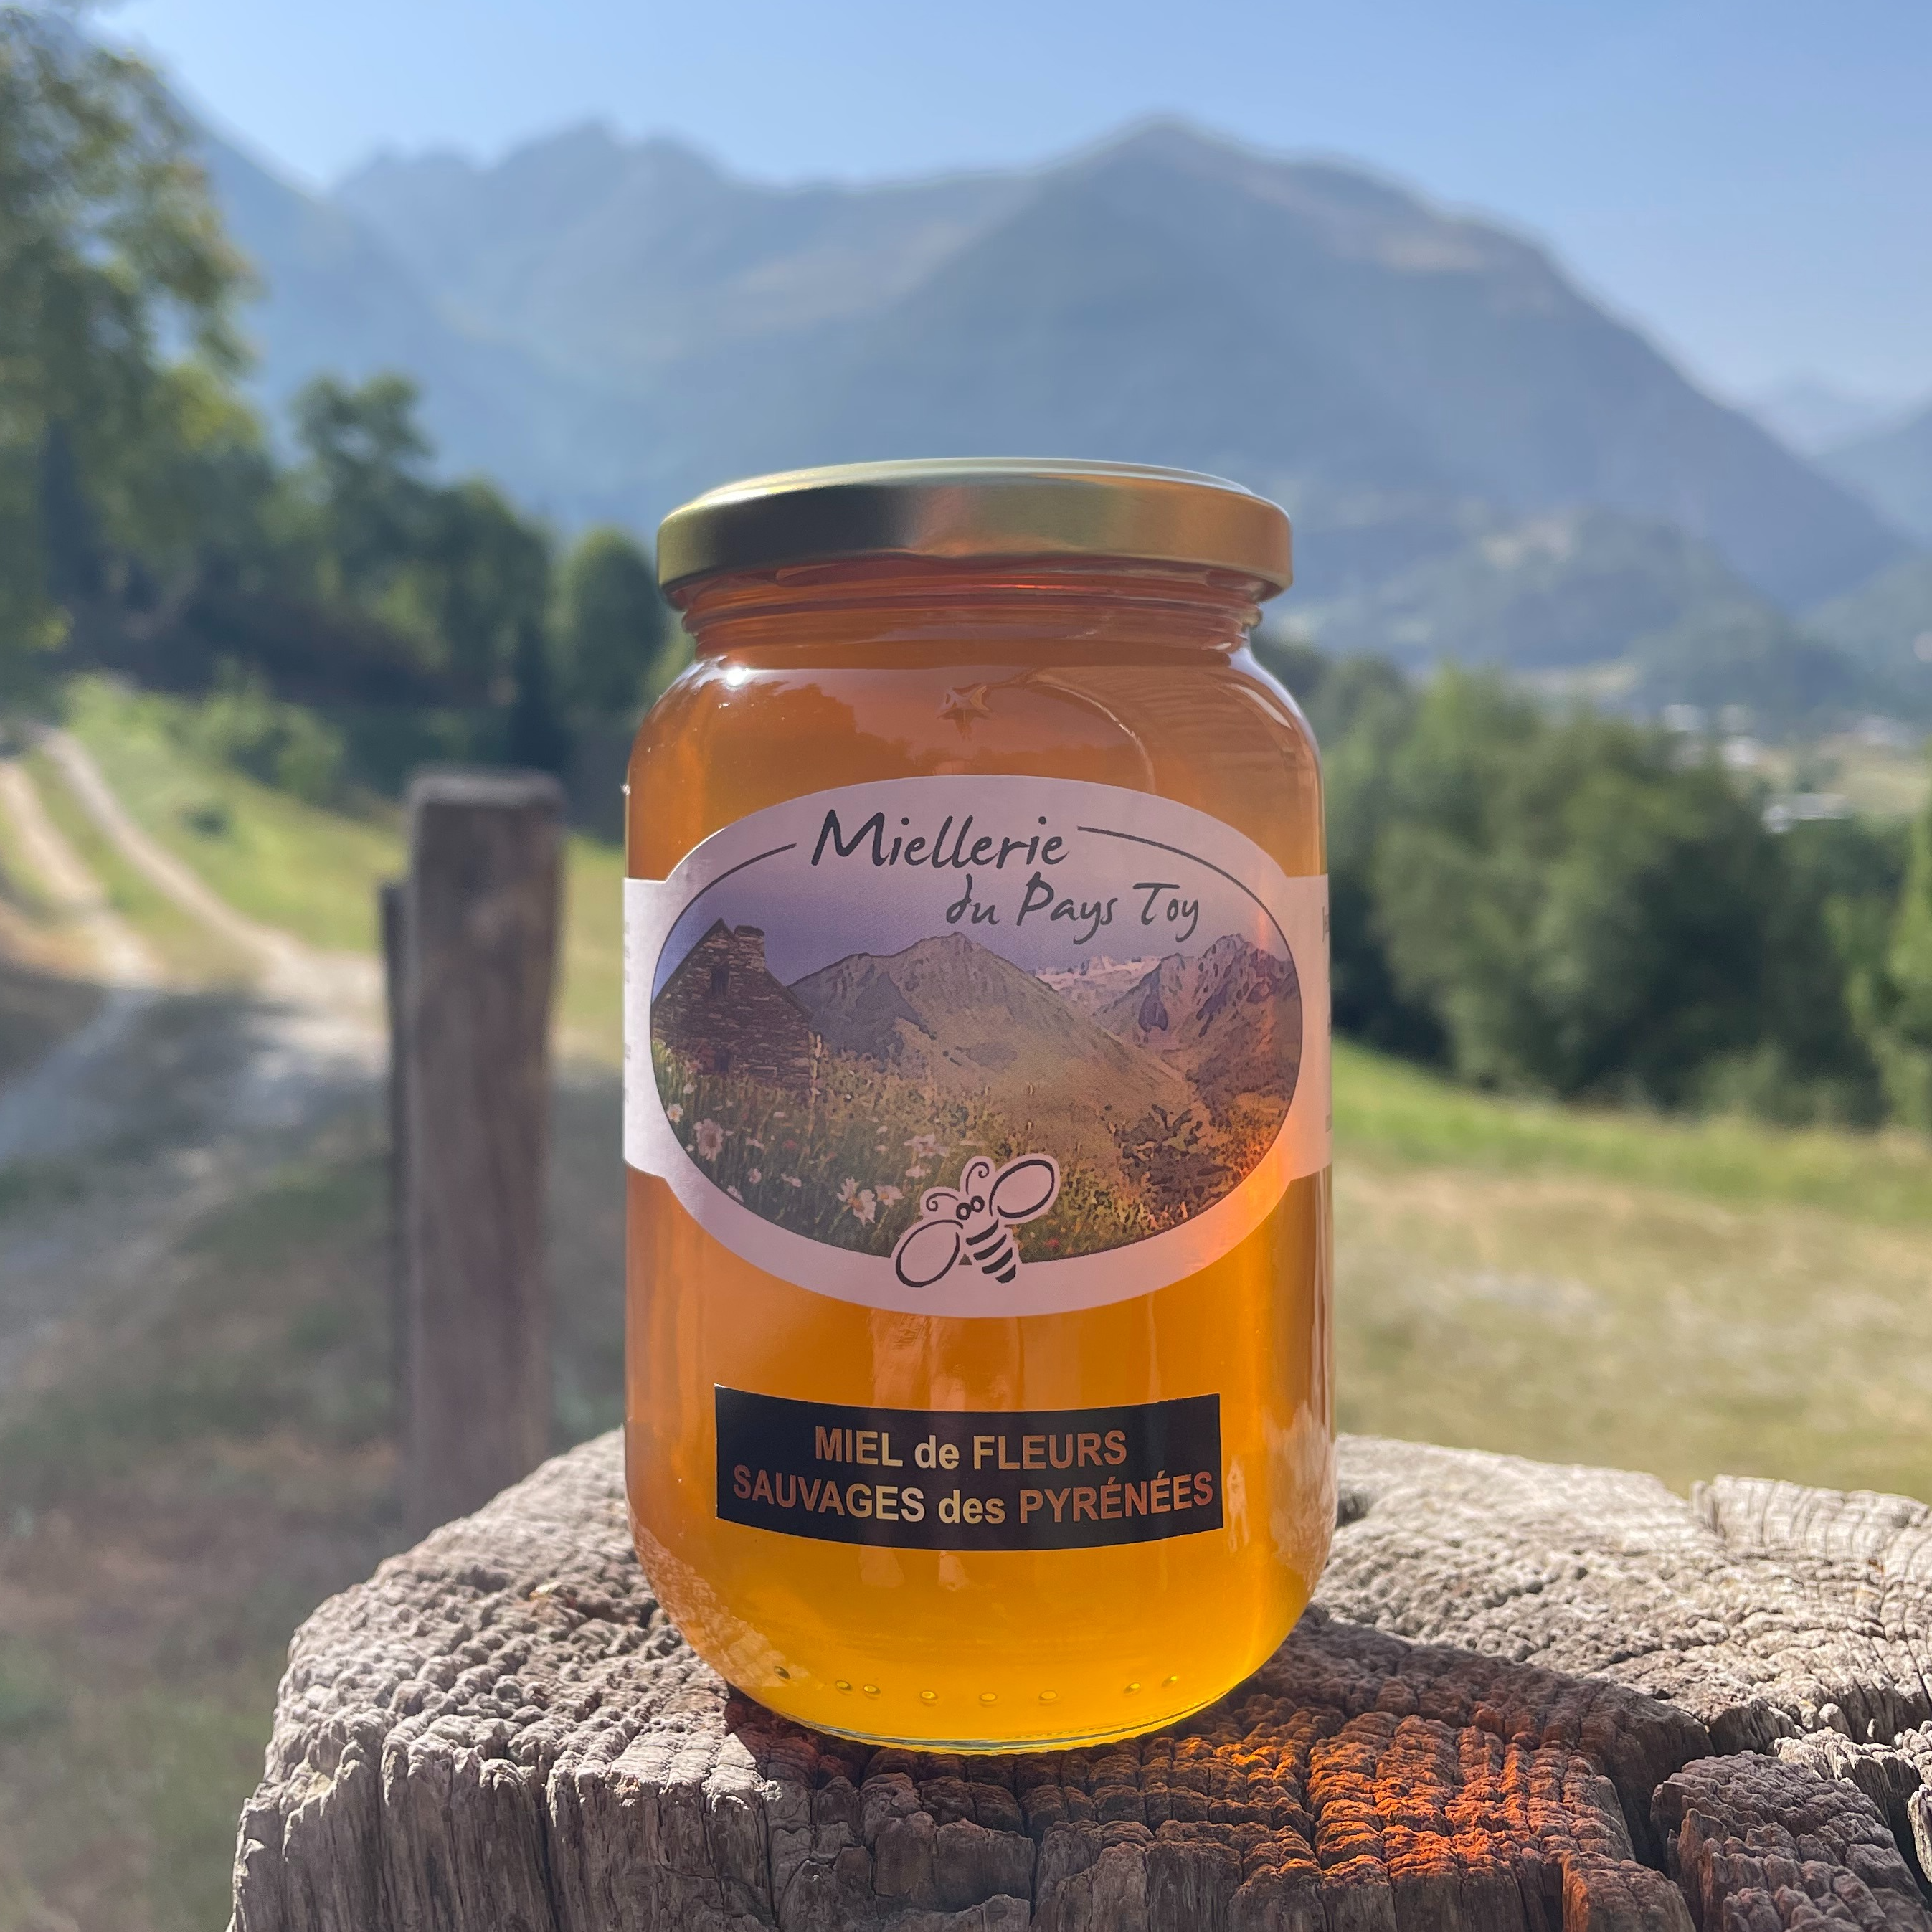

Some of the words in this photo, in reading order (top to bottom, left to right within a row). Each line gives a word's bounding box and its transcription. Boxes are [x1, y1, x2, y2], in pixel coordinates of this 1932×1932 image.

[811, 808, 1069, 869] Miellerie
[946, 873, 1000, 924] du
[1017, 871, 1118, 944] Pays
[1133, 883, 1199, 942] Toy
[815, 1425, 904, 1468] MIEL
[914, 1434, 960, 1469] de
[972, 1429, 1127, 1470] FLEURS
[733, 1464, 925, 1522] SAUVAGES
[937, 1490, 1005, 1525] des
[1019, 1469, 1213, 1524] PYRÉNÉES
